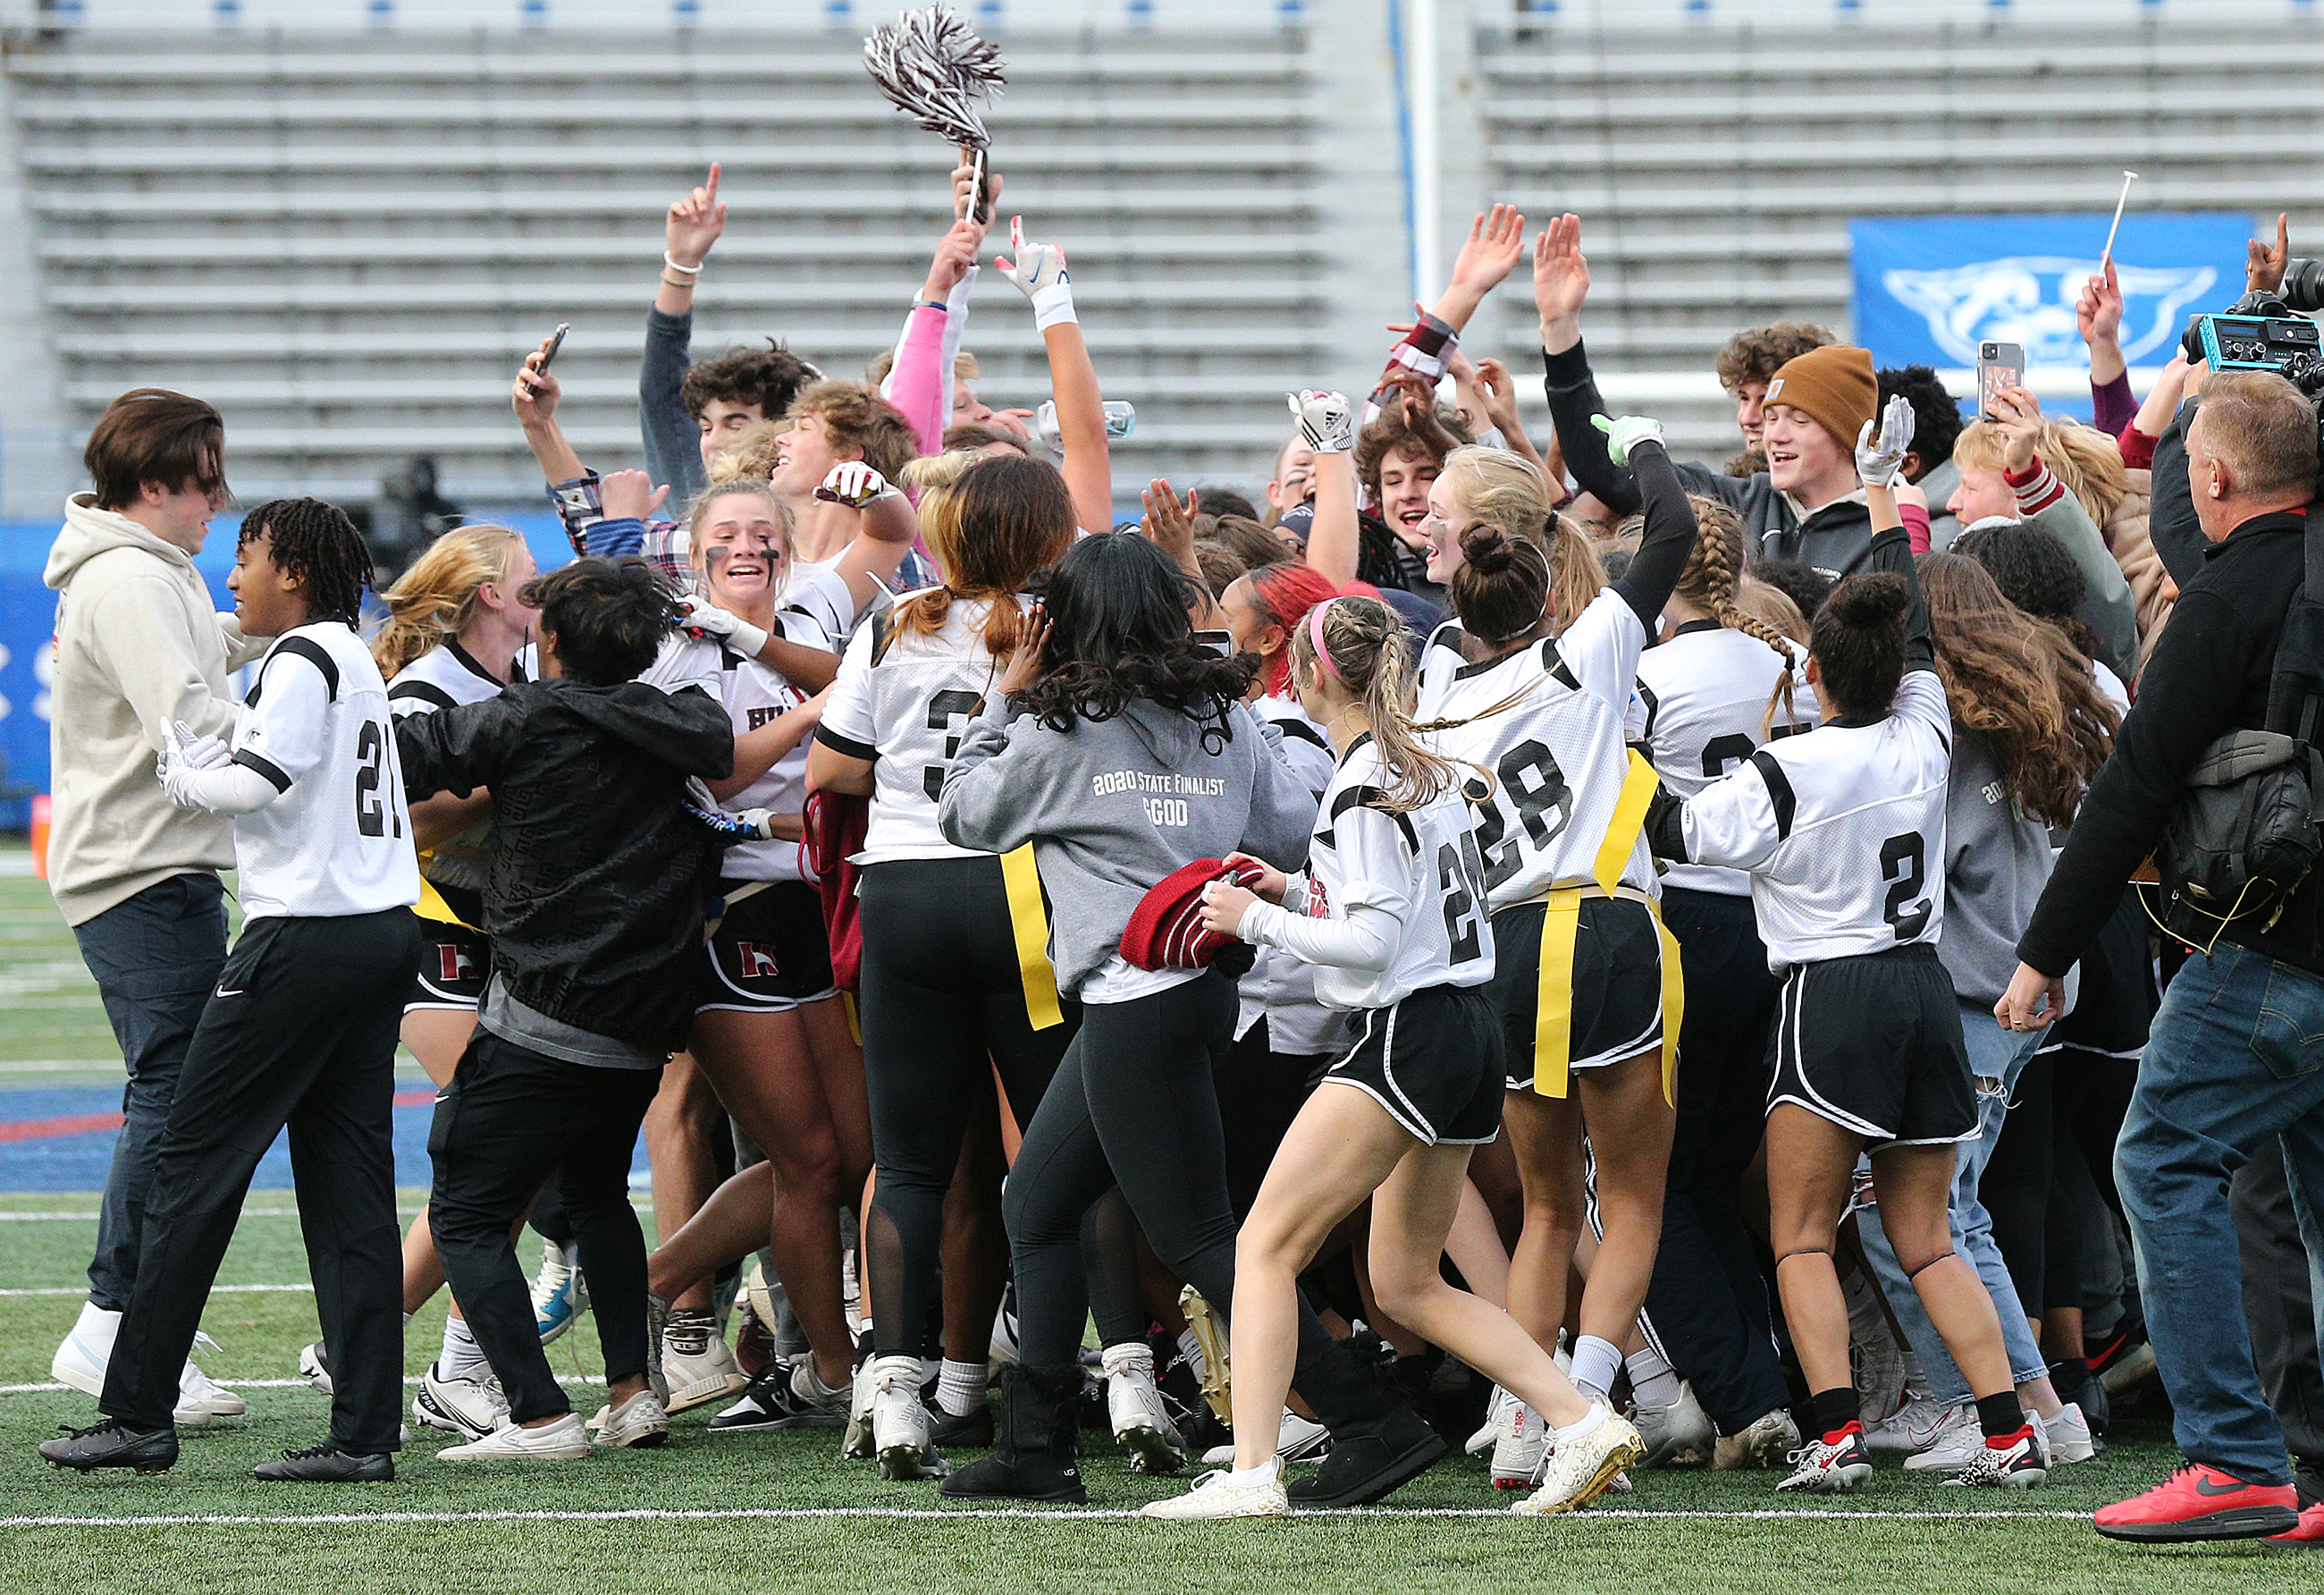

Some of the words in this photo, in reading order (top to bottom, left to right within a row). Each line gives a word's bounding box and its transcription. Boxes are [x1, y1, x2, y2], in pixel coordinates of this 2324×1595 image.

[356, 720, 402, 839] 21
[1092, 770, 1137, 797] 2020
[1137, 771, 1172, 793] STATE
[1175, 772, 1225, 797] FINALIST
[1879, 831, 1932, 941] 2
